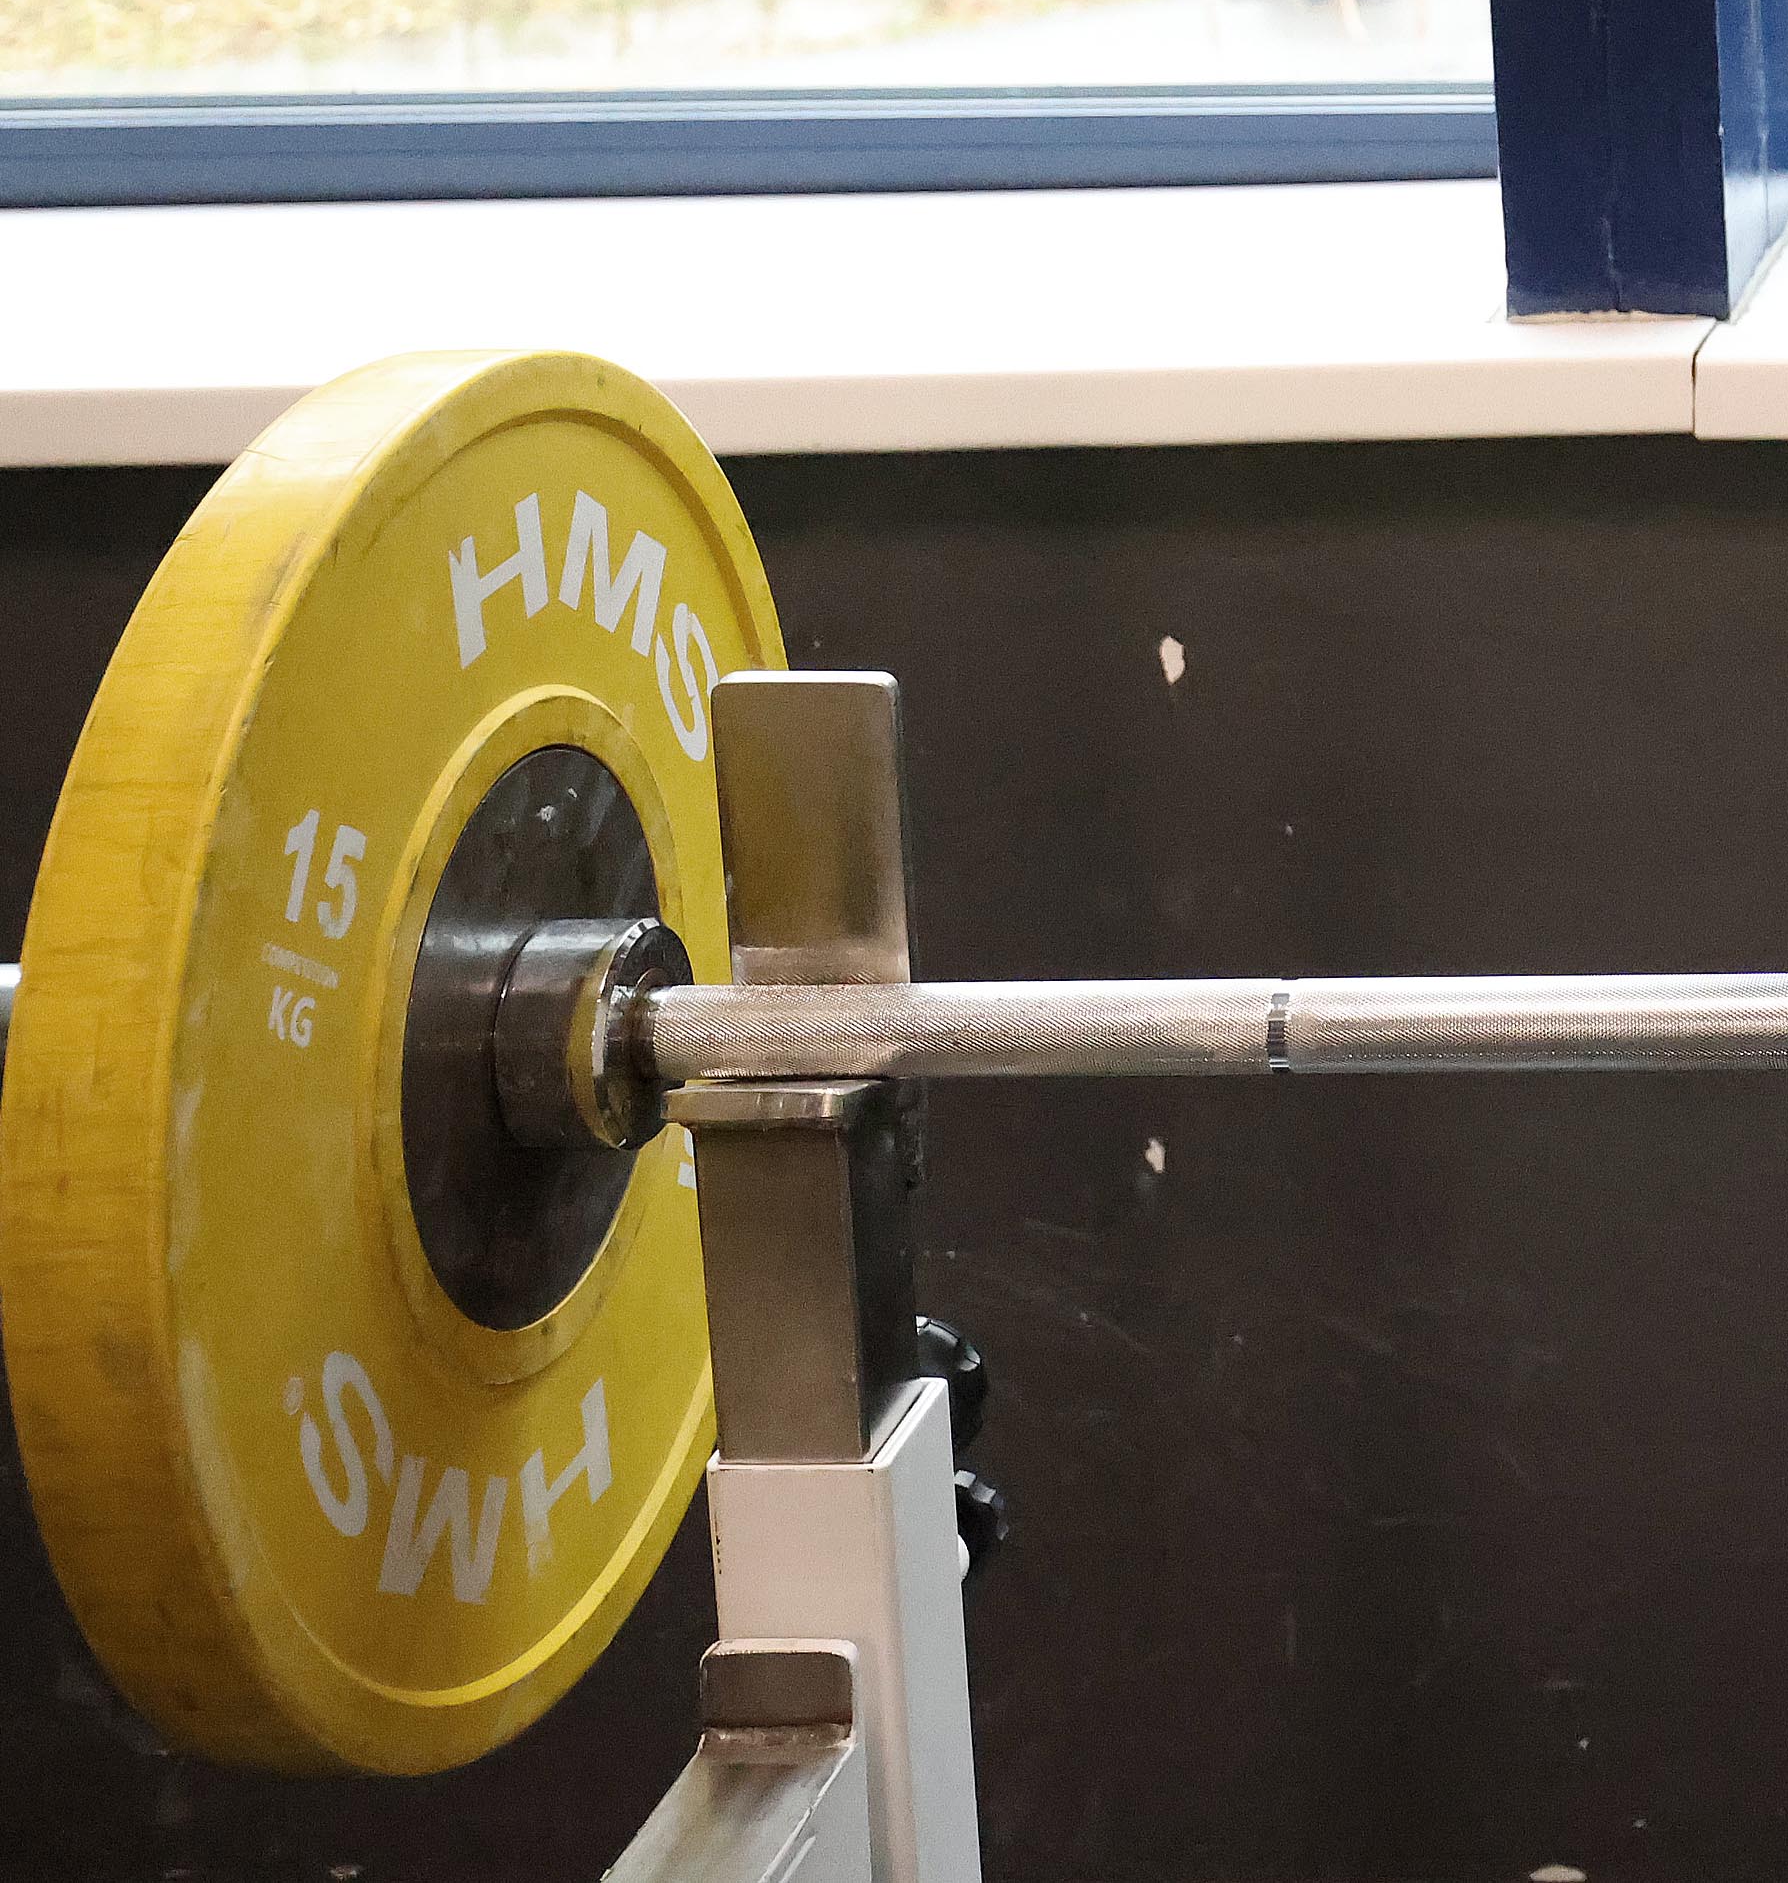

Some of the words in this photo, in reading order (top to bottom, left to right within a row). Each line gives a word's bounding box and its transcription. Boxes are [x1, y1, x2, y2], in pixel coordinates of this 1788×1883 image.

[449, 489, 720, 762] HMS
[284, 808, 367, 940] 15
[267, 985, 316, 1047] KG
